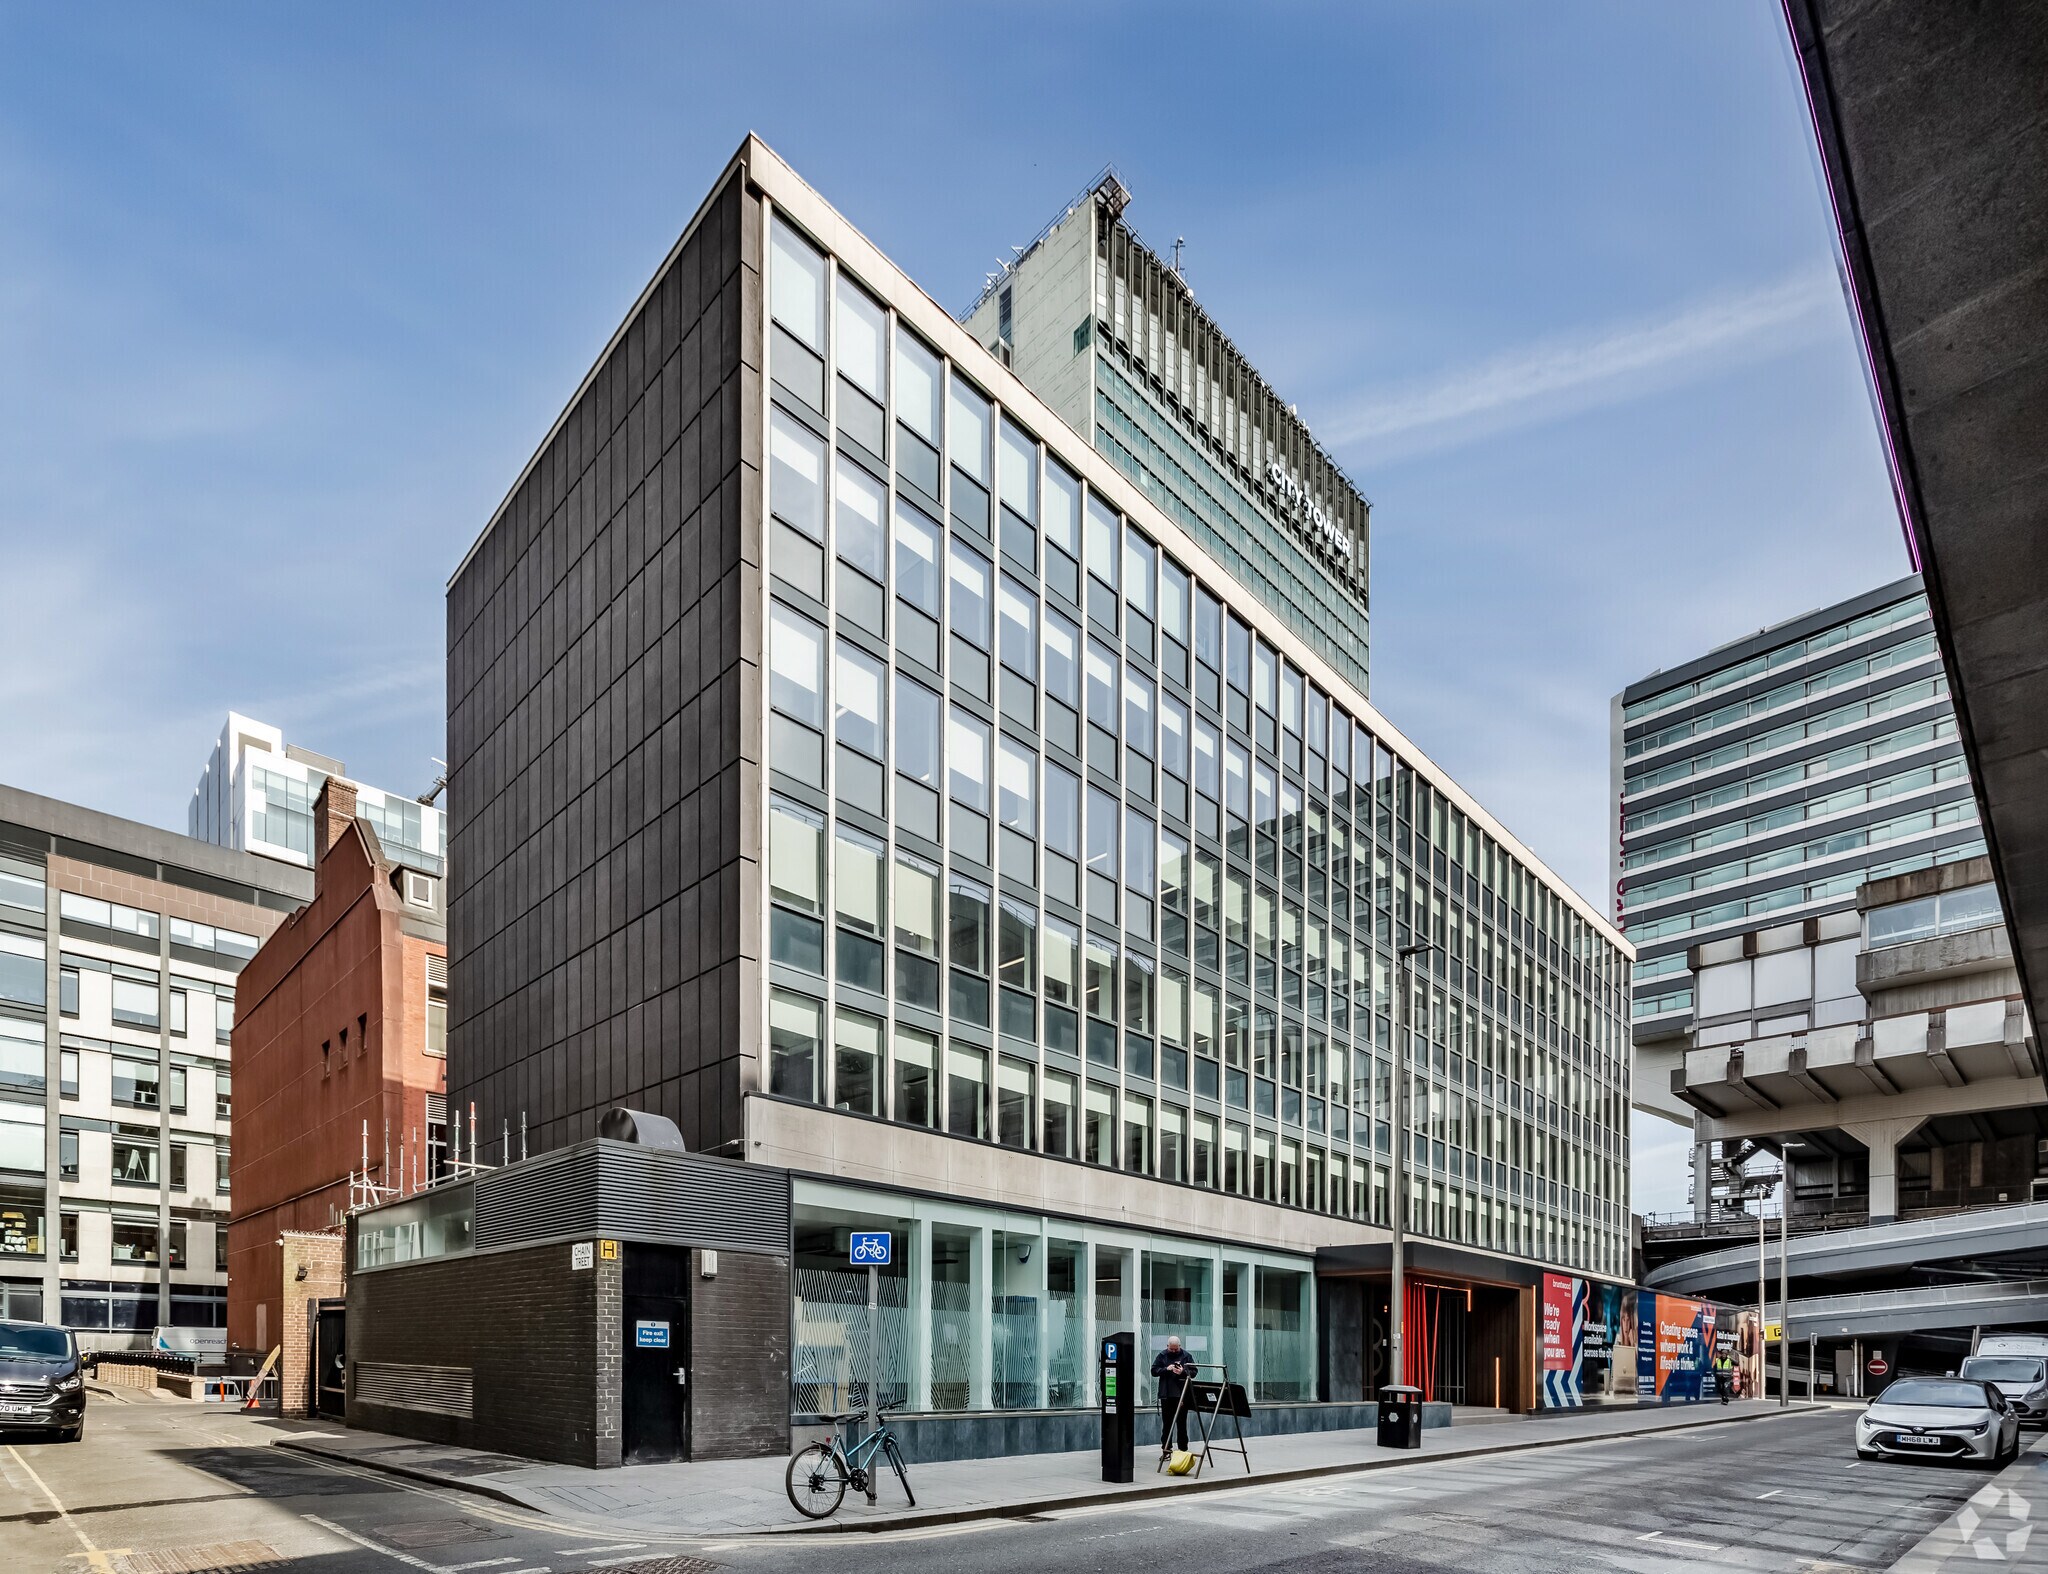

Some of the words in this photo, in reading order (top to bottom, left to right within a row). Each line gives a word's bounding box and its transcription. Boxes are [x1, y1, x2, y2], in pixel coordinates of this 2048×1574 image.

[1272, 463, 1303, 505] CITY
[1306, 497, 1351, 559] TOWER
[575, 1245, 590, 1256] CHAIN
[603, 1242, 615, 1258] H
[1552, 1279, 1571, 1290] bruntwood
[1544, 1303, 1560, 1317] We're
[1544, 1318, 1560, 1333] ready
[1584, 1321, 1607, 1334] Workspace
[1660, 1321, 1681, 1340] Creating
[1682, 1326, 1699, 1340] spaces
[1544, 1331, 1560, 1344] when
[1584, 1334, 1603, 1345] available
[1108, 1344, 1115, 1358] P
[1584, 1348, 1599, 1358] across
[1660, 1339, 1676, 1353] where
[1677, 1341, 1689, 1354] work
[1689, 1341, 1693, 1354] &
[1544, 1348, 1555, 1360] you
[1555, 1348, 1566, 1358] are.
[1660, 1355, 1680, 1373] lifestyle
[1681, 1357, 1696, 1370] thrive.
[11, 1405, 28, 1413] UMC
